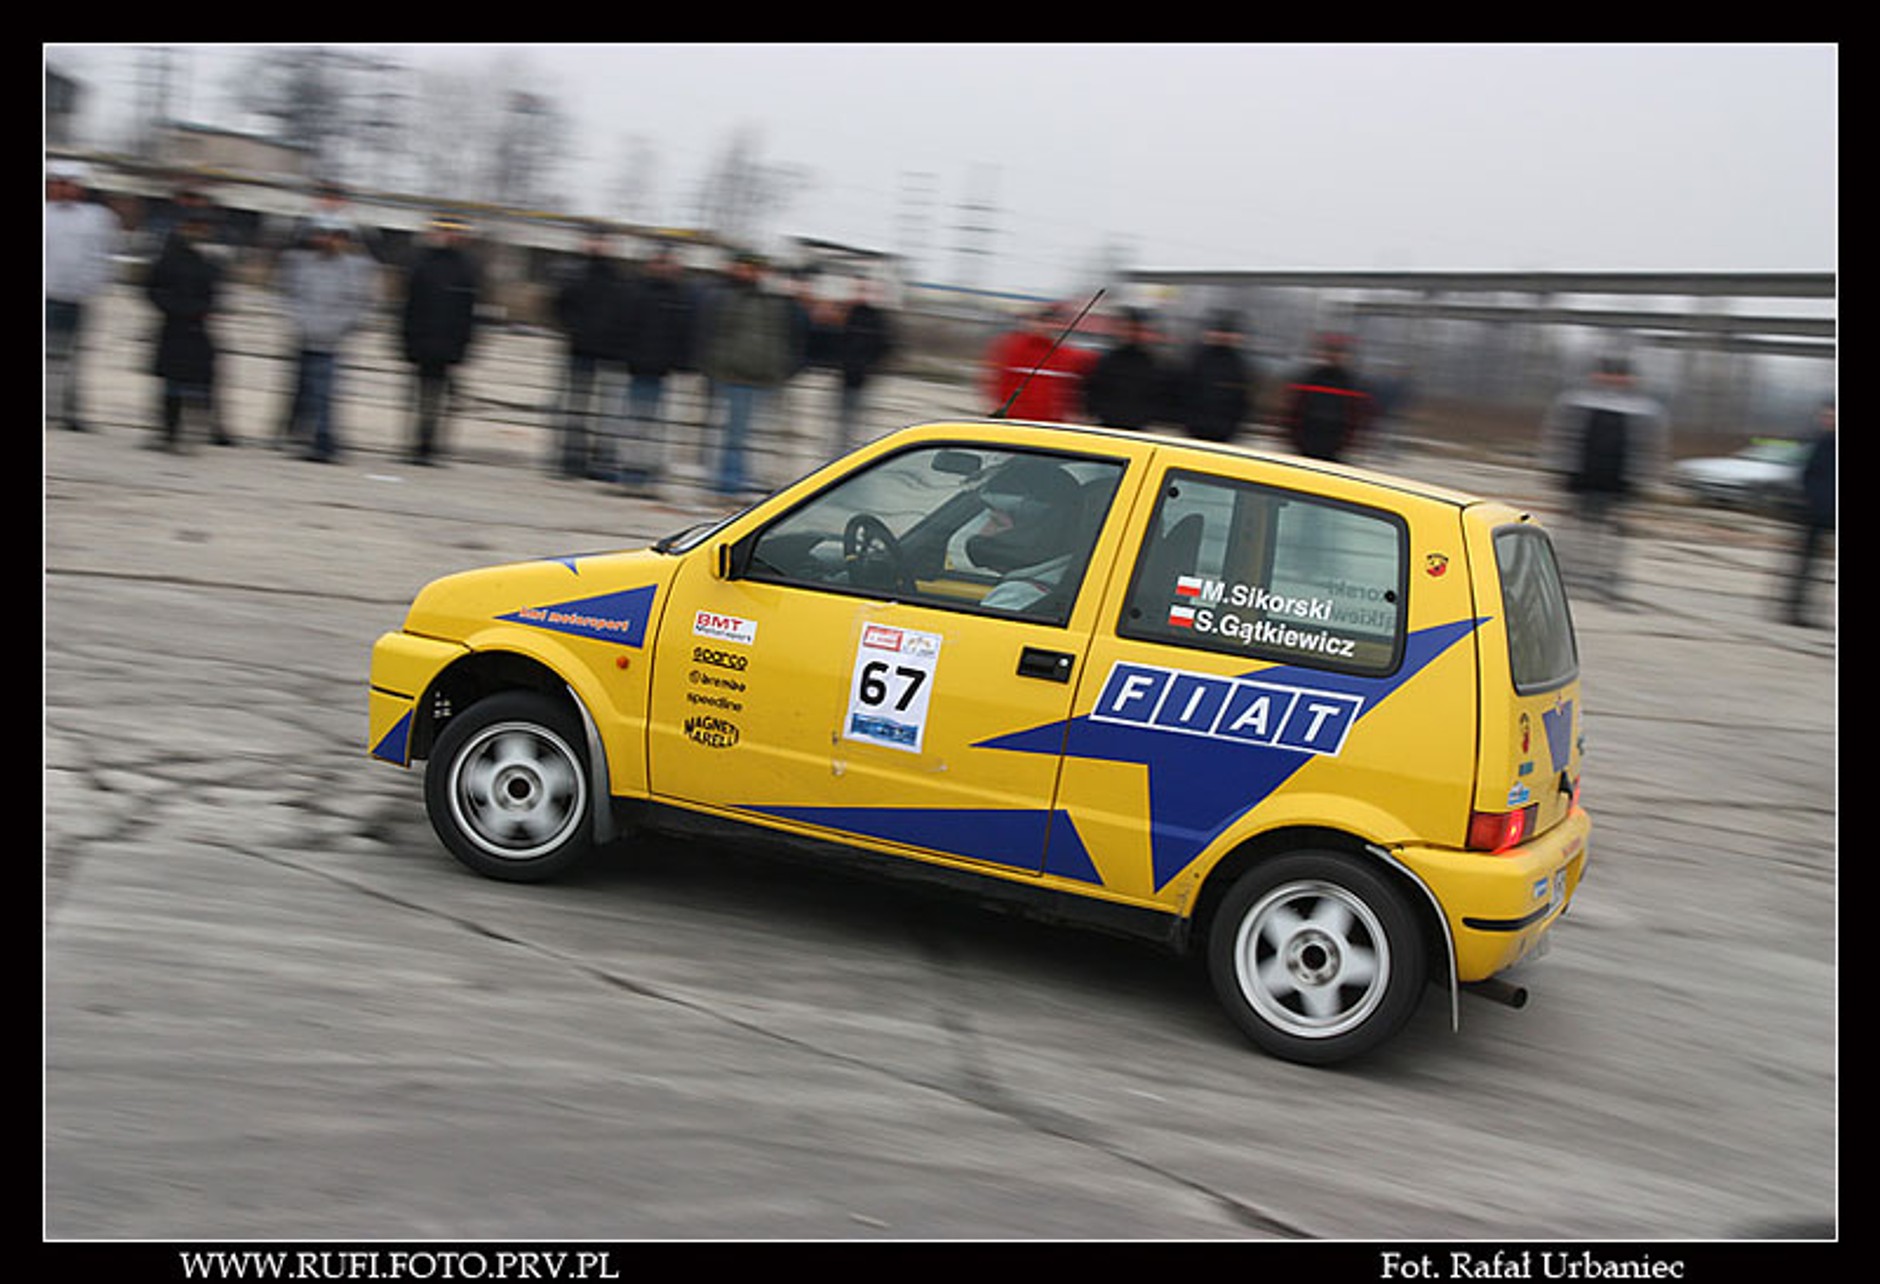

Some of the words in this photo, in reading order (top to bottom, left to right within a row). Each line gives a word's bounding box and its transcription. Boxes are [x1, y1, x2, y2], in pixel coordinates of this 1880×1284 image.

[697, 613, 744, 631] BMT
[1200, 580, 1333, 620] M.Sikorski
[1193, 609, 1356, 658] S.Gątkiewicz
[693, 646, 749, 671] sparco
[859, 660, 928, 712] 67
[1112, 674, 1341, 744] FIAT
